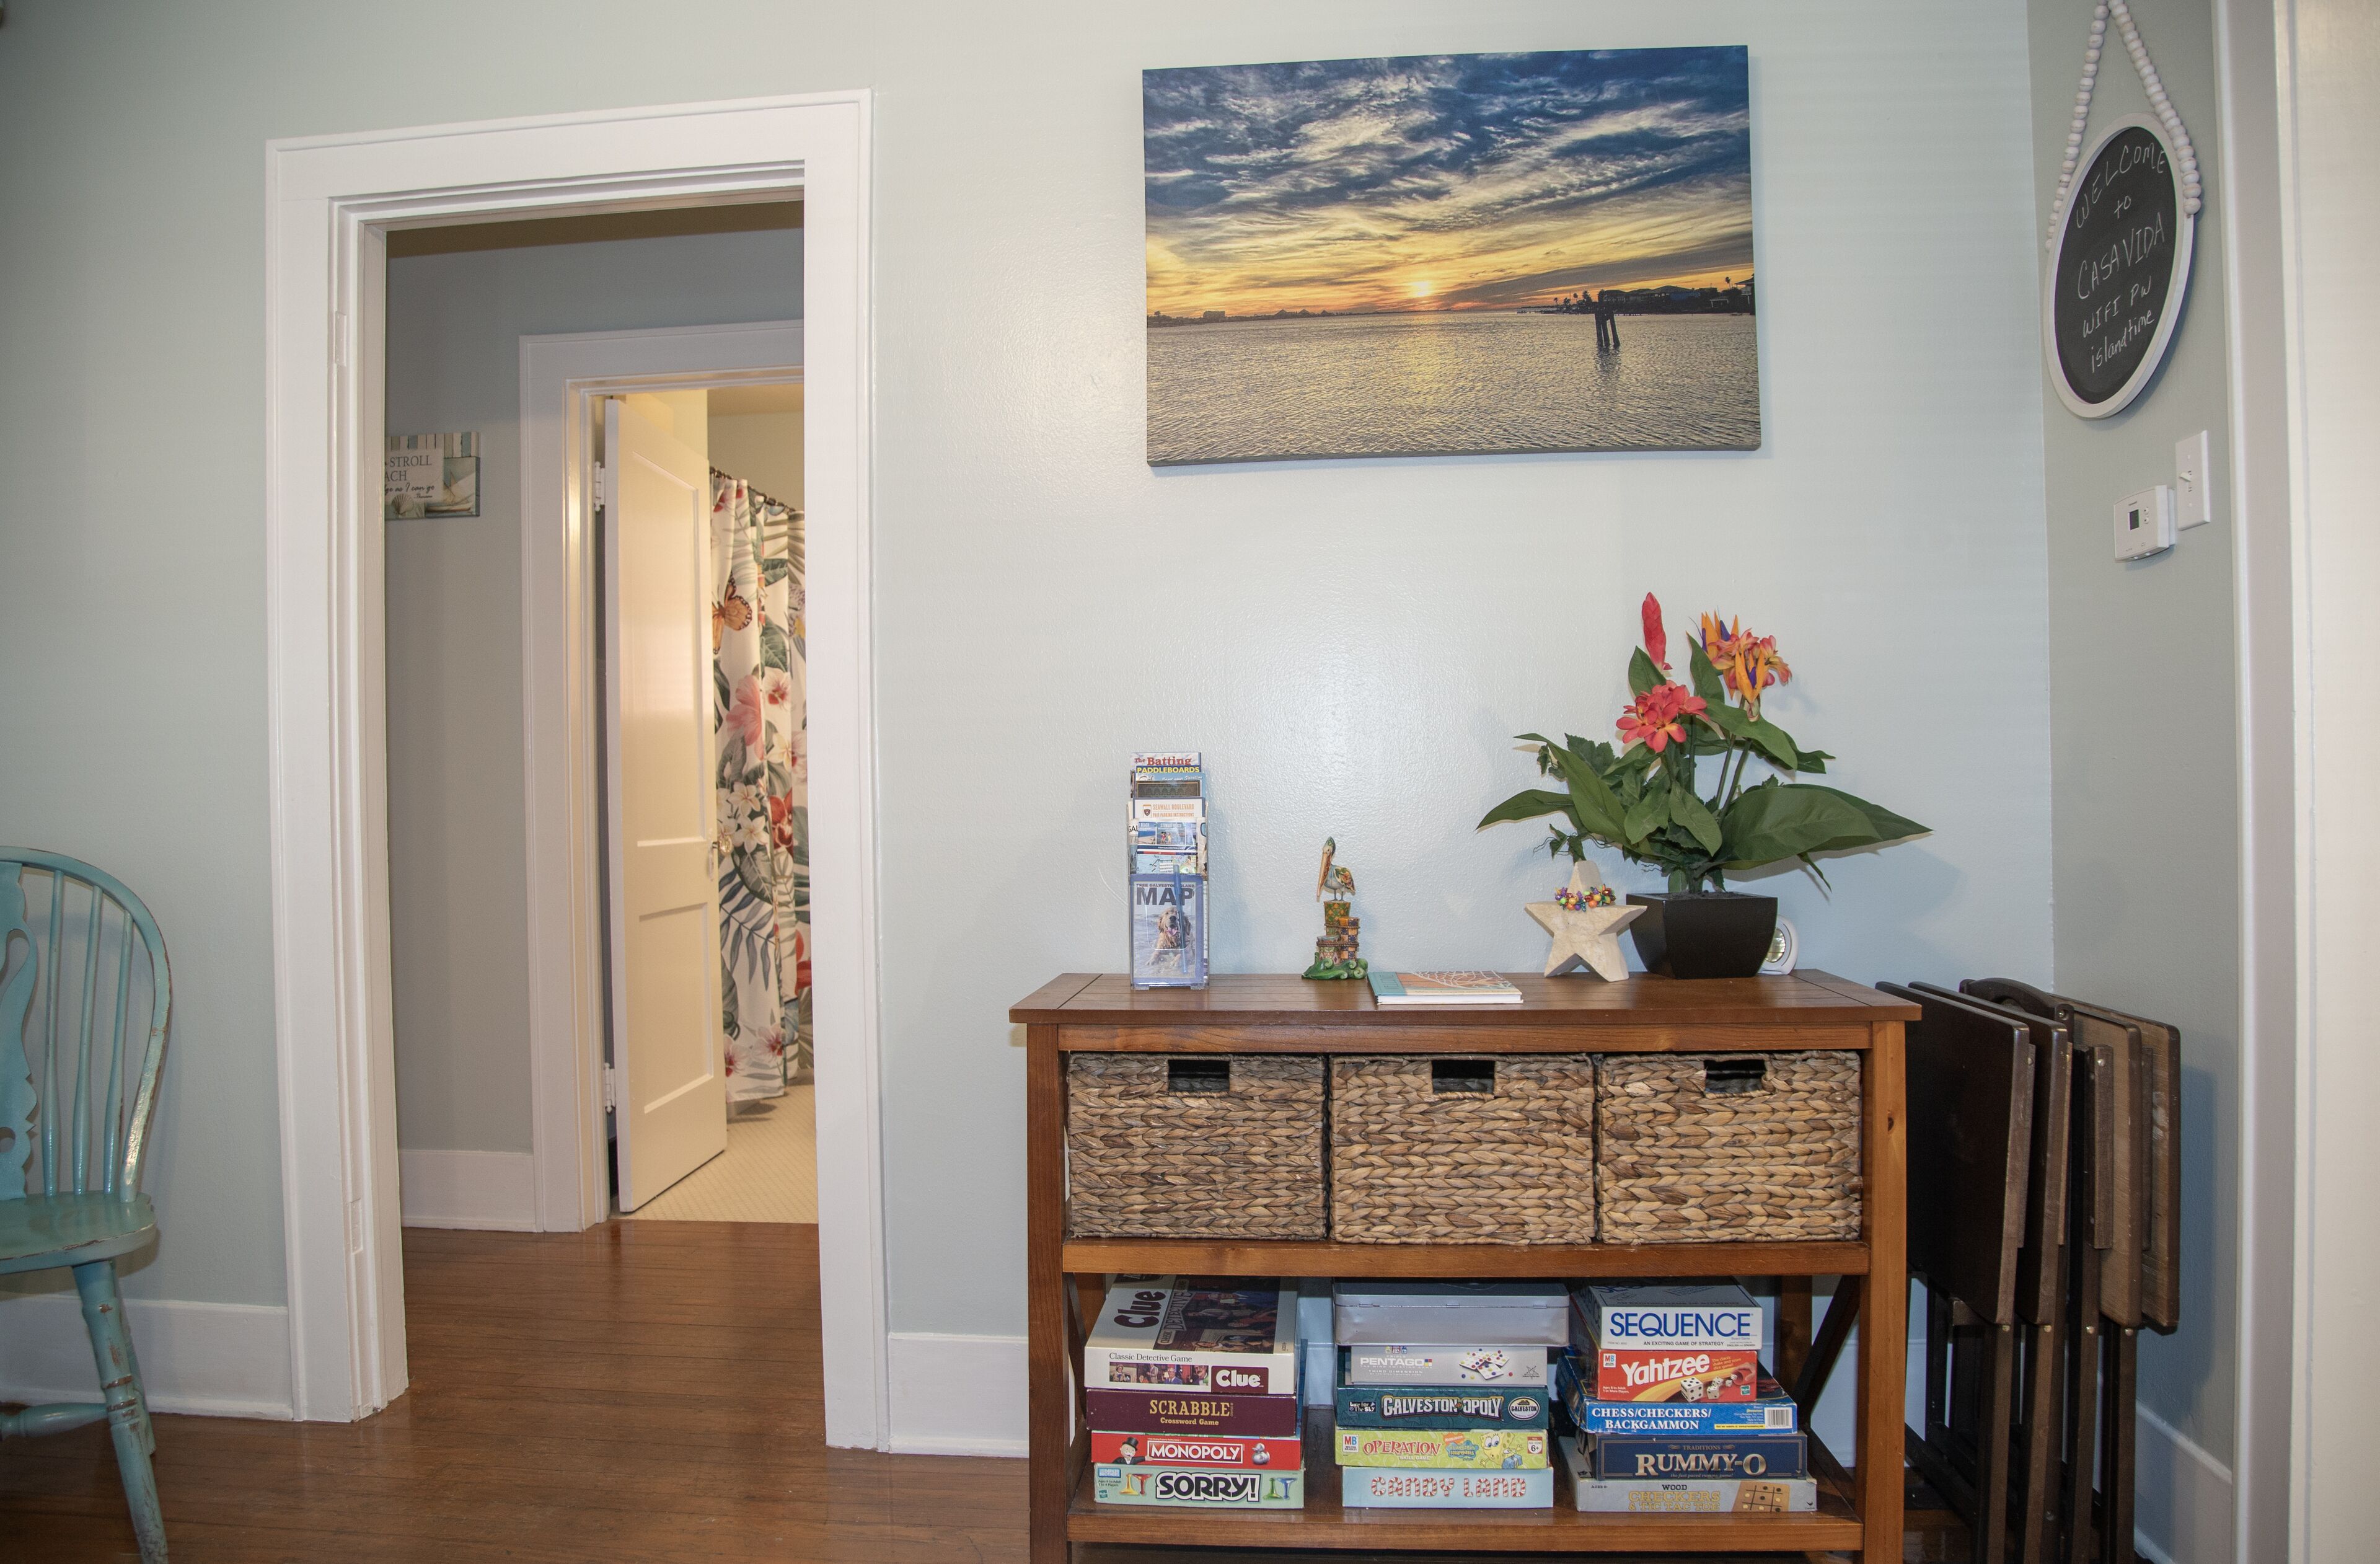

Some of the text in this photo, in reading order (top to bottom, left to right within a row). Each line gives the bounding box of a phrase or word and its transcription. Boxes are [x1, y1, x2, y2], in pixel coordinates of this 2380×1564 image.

[2076, 143, 2167, 229] WELCOME
[2114, 195, 2131, 219] to
[390, 455, 432, 467] STROLL
[426, 485, 435, 494] go
[1147, 756, 1192, 766] Batting
[1136, 887, 1194, 906] MAP
[1114, 1291, 1166, 1328] Clue
[1164, 1292, 1194, 1330] DETECTIVE
[1610, 1312, 1751, 1337] SEQUENCE
[1109, 1353, 1192, 1363] Classic Detective Game
[1360, 1358, 1424, 1366] PENTAGO
[1215, 1369, 1261, 1387] Clue
[1621, 1354, 1711, 1387] Yahtzee
[1150, 1400, 1230, 1416] SCRABBLE
[1605, 1420, 1699, 1430] BACKGAMMON
[1345, 1436, 1357, 1445] MB
[1364, 1440, 1441, 1456] OPERATION
[1151, 1444, 1240, 1460] MONOPOLY
[1635, 1454, 1766, 1476] RUMMY-O
[1158, 1472, 1259, 1500] SORRY!
[1370, 1477, 1527, 1498] CANDY LAND
[1629, 1491, 1721, 1502] CHECKERS
[1629, 1503, 1721, 1511] & TIC TAC TOE
